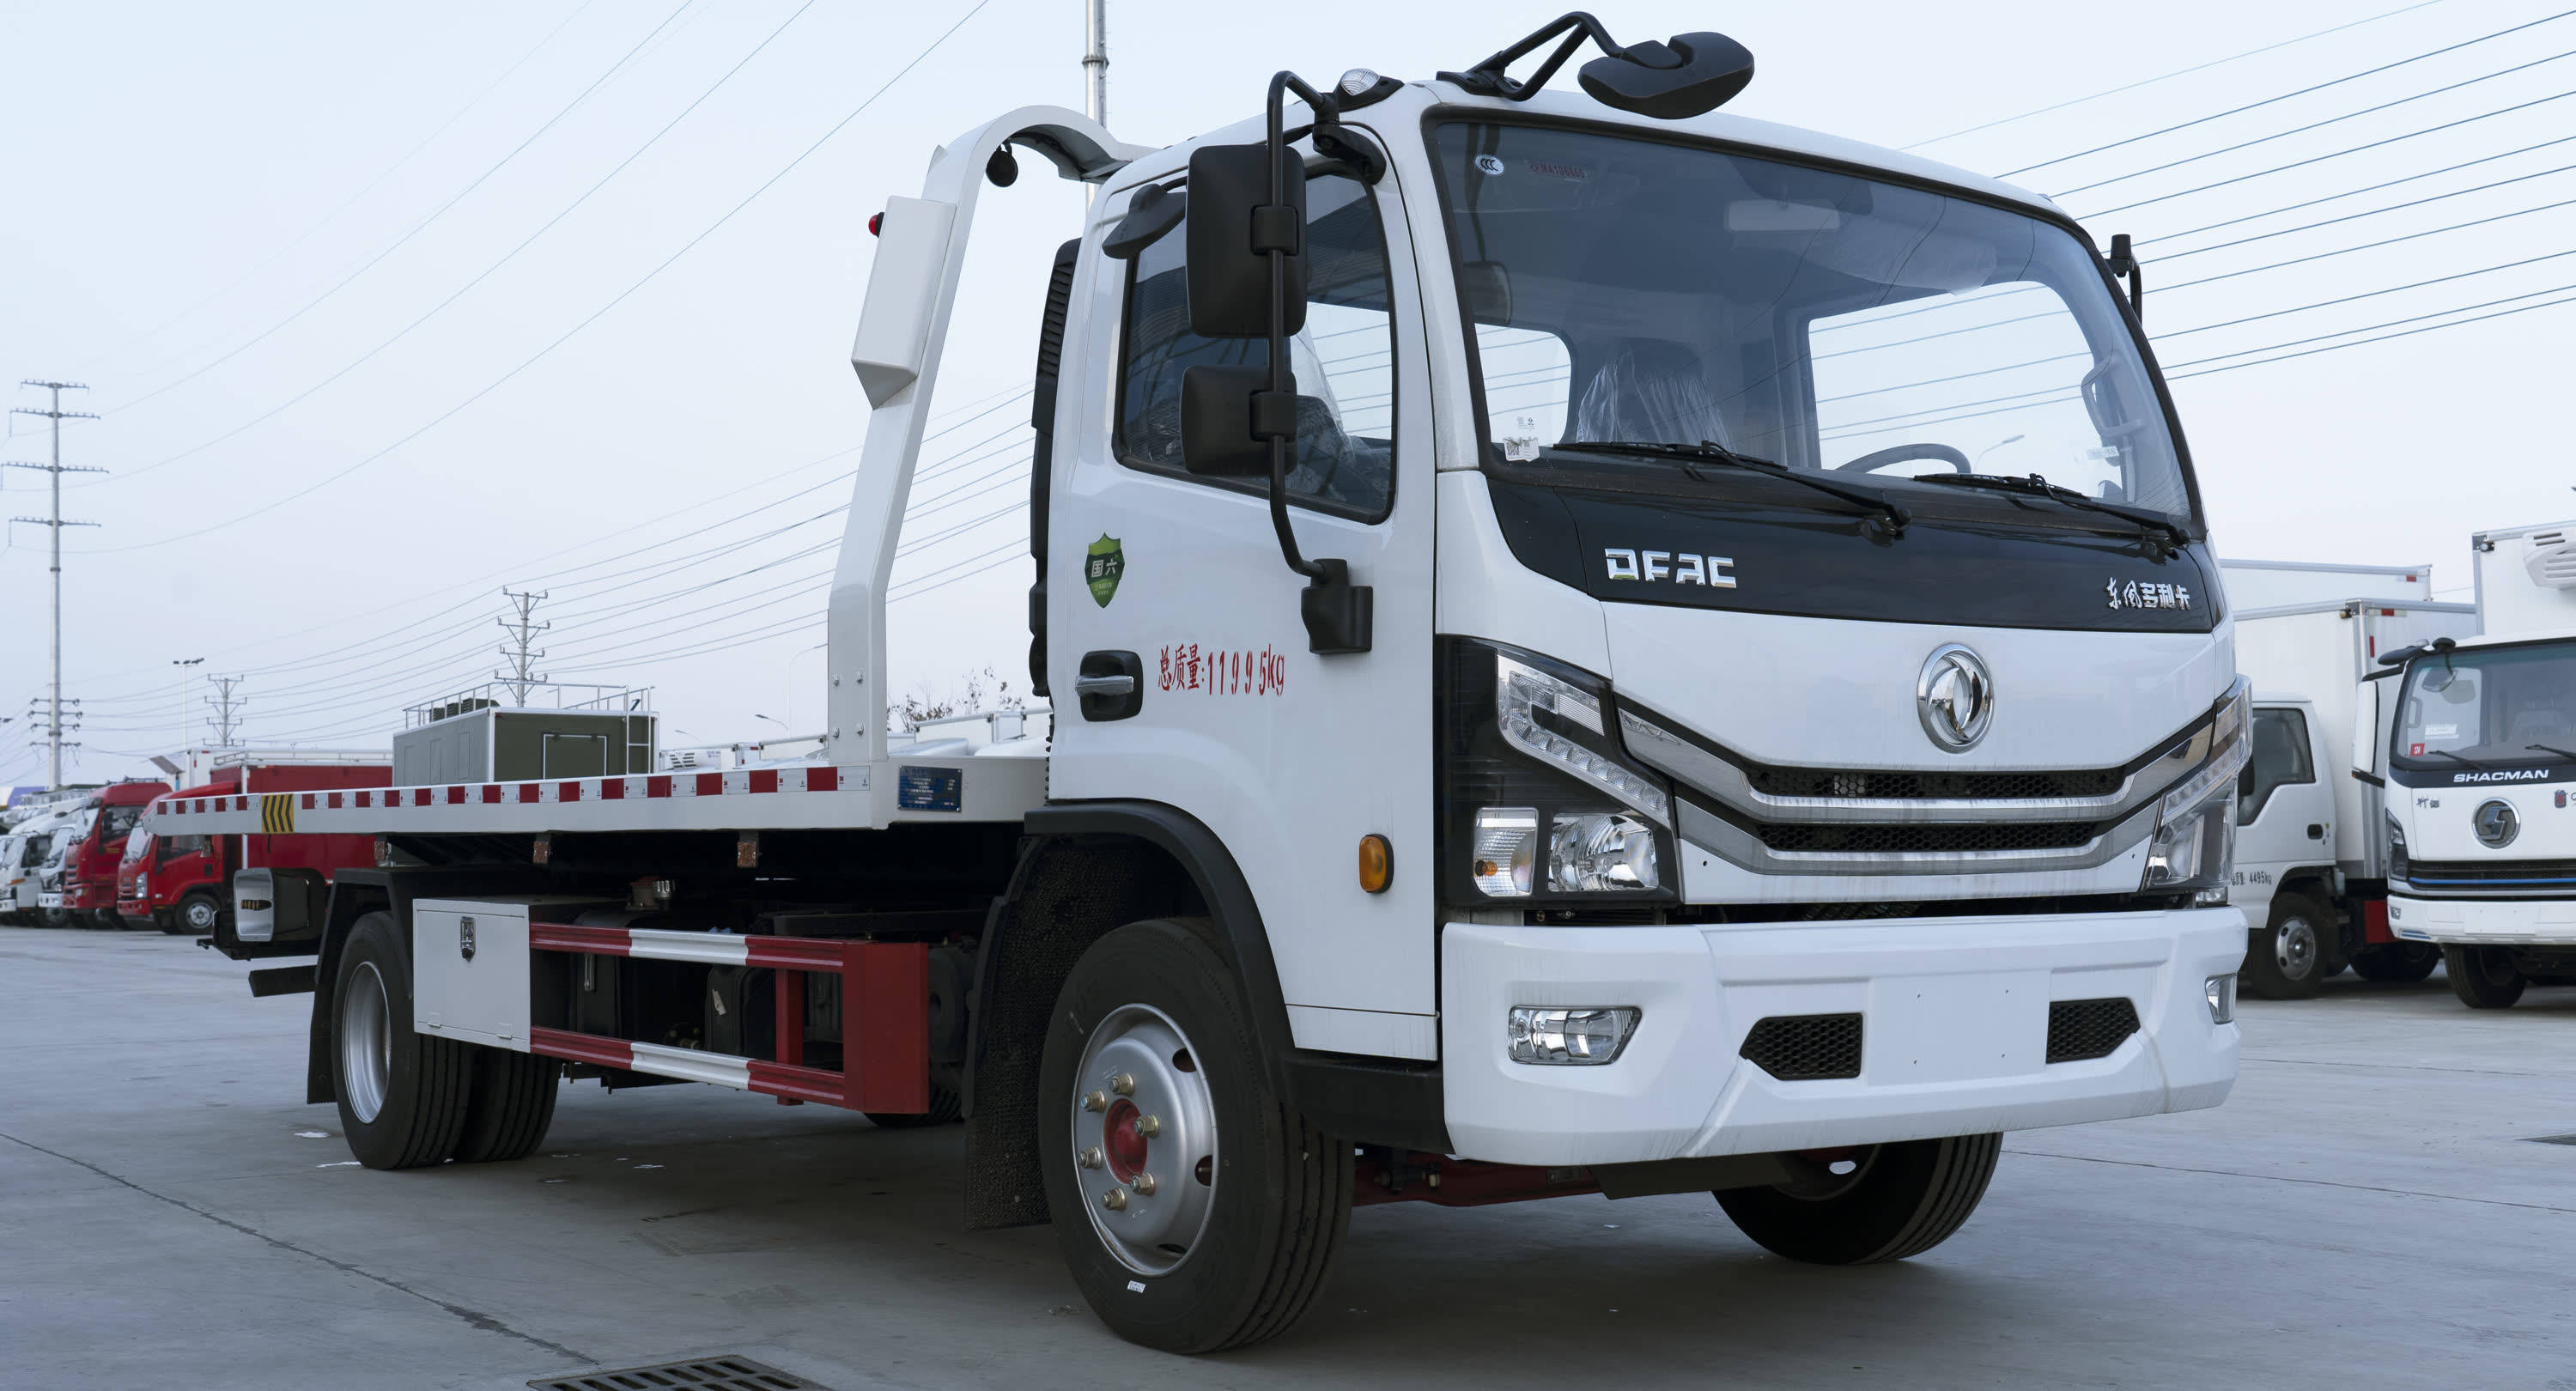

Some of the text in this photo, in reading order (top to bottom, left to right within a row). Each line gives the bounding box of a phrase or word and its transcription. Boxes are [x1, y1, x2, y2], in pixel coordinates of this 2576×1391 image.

[1091, 558, 1118, 578] 国六
[1604, 548, 1737, 589] DFAC
[2453, 769, 2549, 782] SHACMAN
